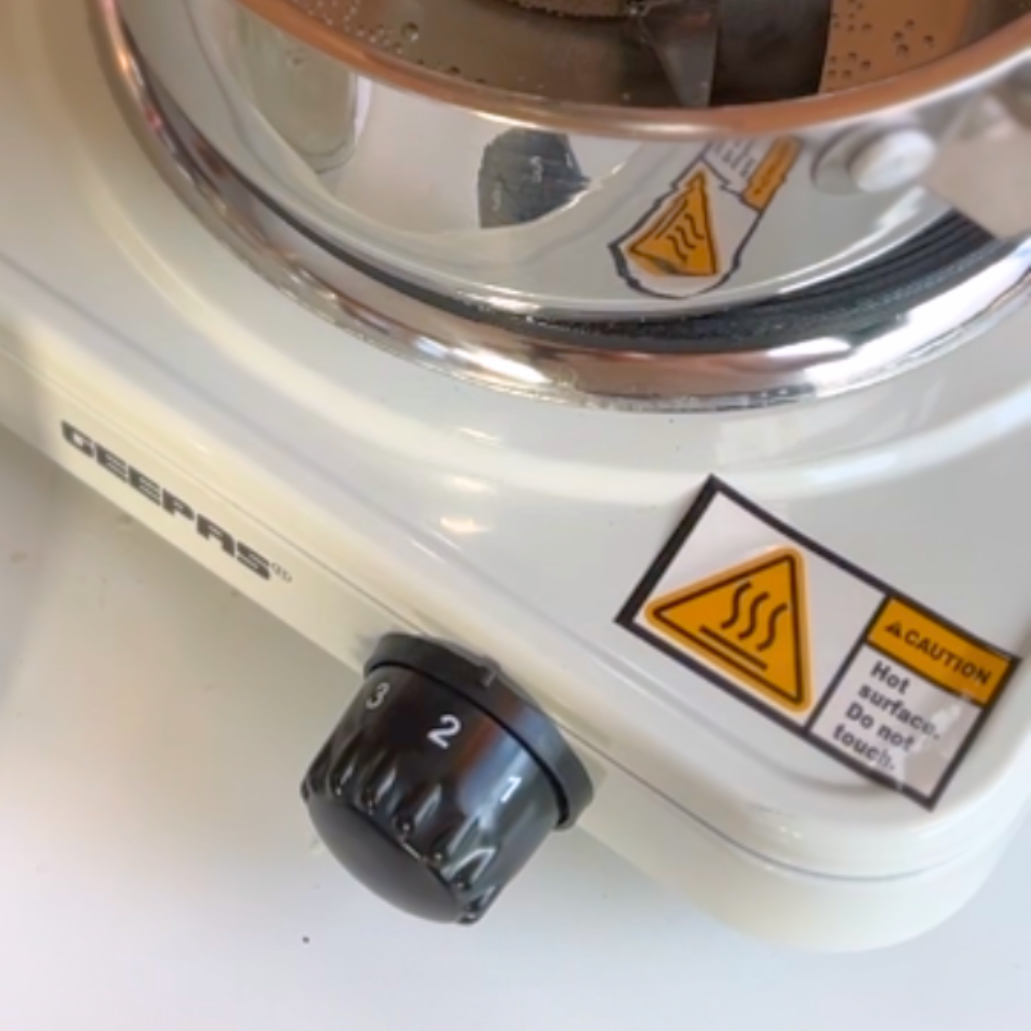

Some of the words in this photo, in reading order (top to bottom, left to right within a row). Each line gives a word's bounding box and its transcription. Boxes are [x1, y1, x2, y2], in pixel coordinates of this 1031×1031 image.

[61, 419, 271, 581] GEEPAS
[870, 660, 910, 694] Hot
[903, 629, 992, 686] CAUTION
[365, 682, 390, 709] 3
[857, 684, 940, 740] surface.
[427, 714, 462, 749] 2
[845, 701, 874, 729] Do
[877, 723, 915, 752] not
[500, 776, 522, 803] 1
